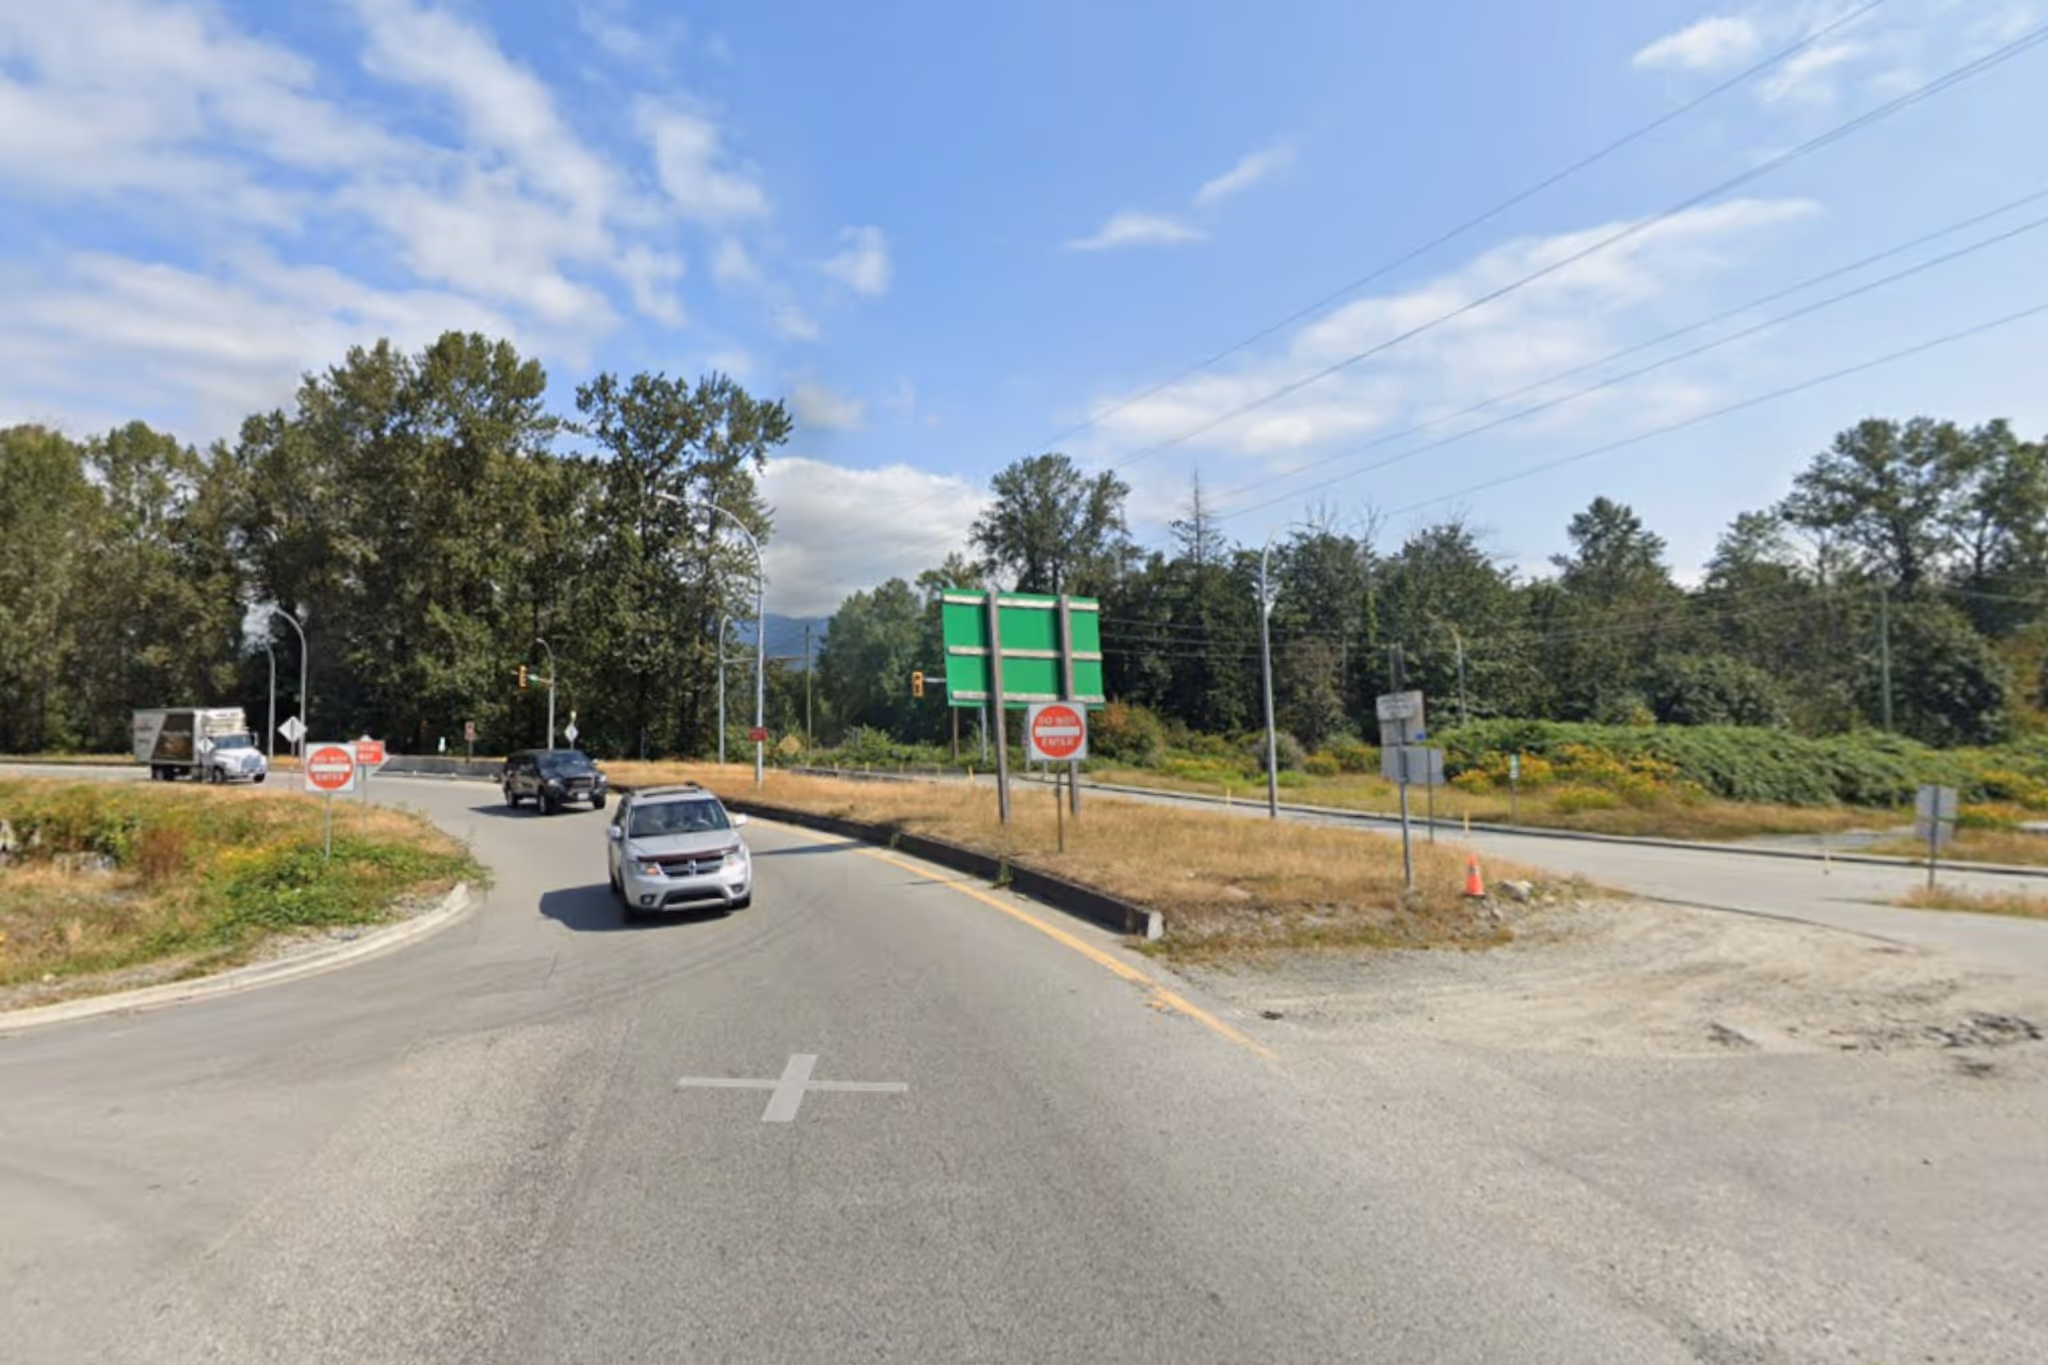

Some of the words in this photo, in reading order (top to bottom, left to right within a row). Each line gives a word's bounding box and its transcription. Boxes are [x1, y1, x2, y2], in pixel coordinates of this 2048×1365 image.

[1037, 715, 1053, 727] DO
[1056, 715, 1077, 727] NOT
[1042, 736, 1075, 748] ENTER
